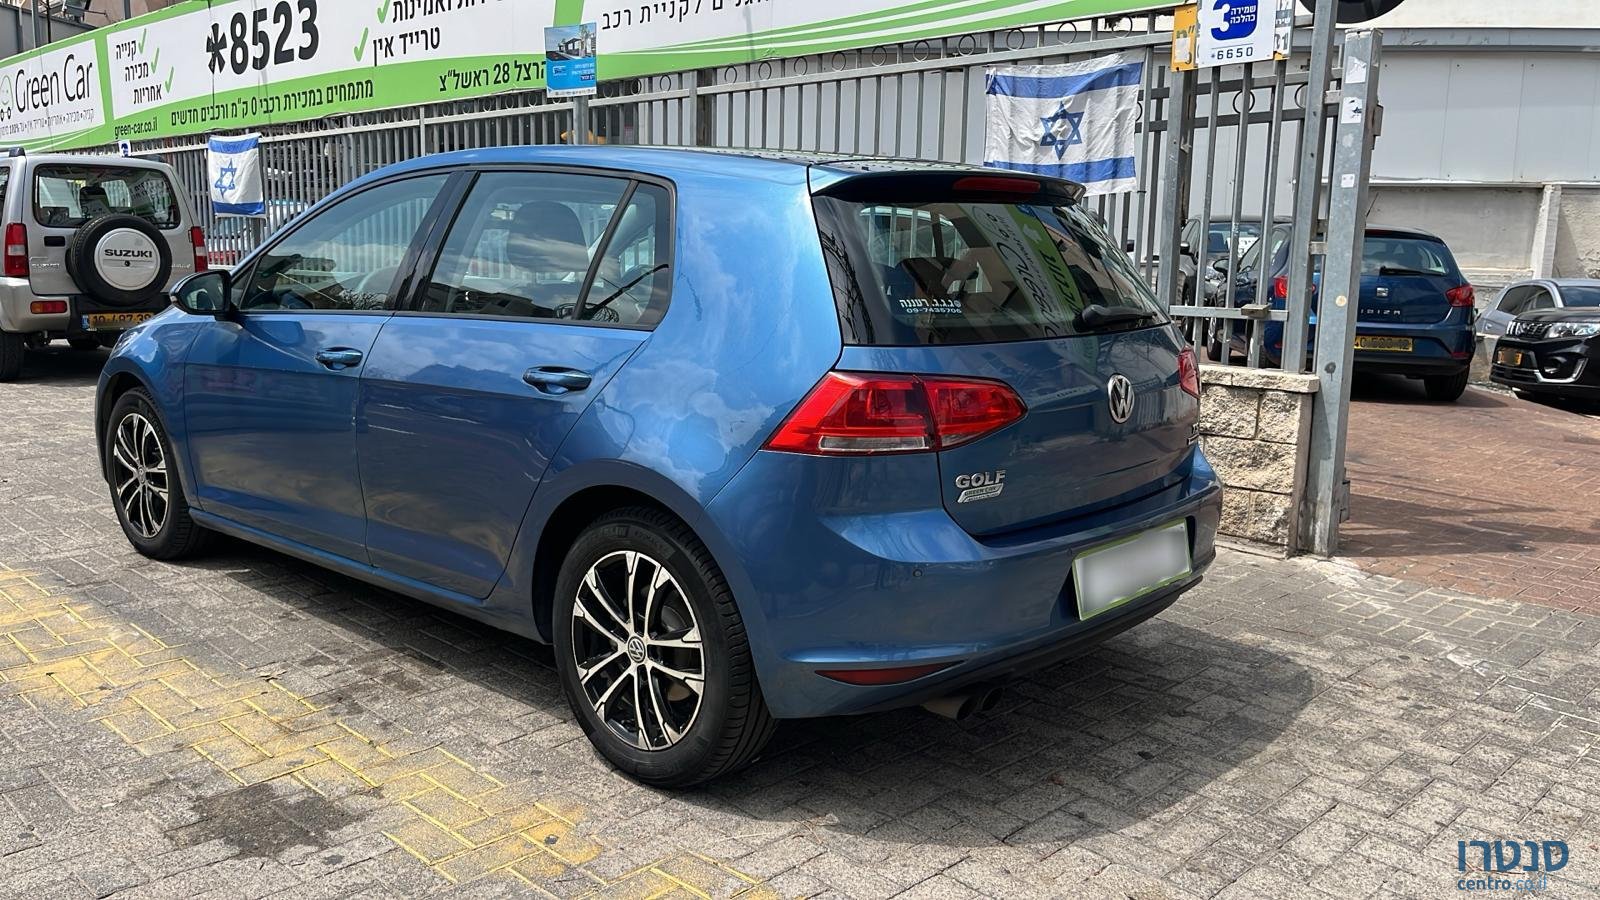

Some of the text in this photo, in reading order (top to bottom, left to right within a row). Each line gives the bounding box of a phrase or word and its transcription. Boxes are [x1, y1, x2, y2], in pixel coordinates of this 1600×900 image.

[602, 9, 633, 30] רכב
[1229, 14, 1256, 25] כהלכה
[1230, 5, 1257, 17] שמירה
[116, 40, 137, 61] קנייה
[372, 26, 441, 67] טרייד אין
[125, 62, 149, 82] מכירה
[493, 62, 510, 85] 28
[15, 54, 93, 112] Green Car
[326, 79, 373, 104] מתמחים
[133, 83, 162, 105] אחריות
[283, 88, 323, 112] במכירת
[200, 103, 229, 123] ורכבים
[259, 95, 281, 115] רכבי
[114, 116, 158, 139] green-car.co.il
[171, 108, 199, 127] חדשים
[104, 249, 153, 258] SUZUKI
[899, 298, 930, 308] רעננה
[955, 470, 1006, 489] GOLF
